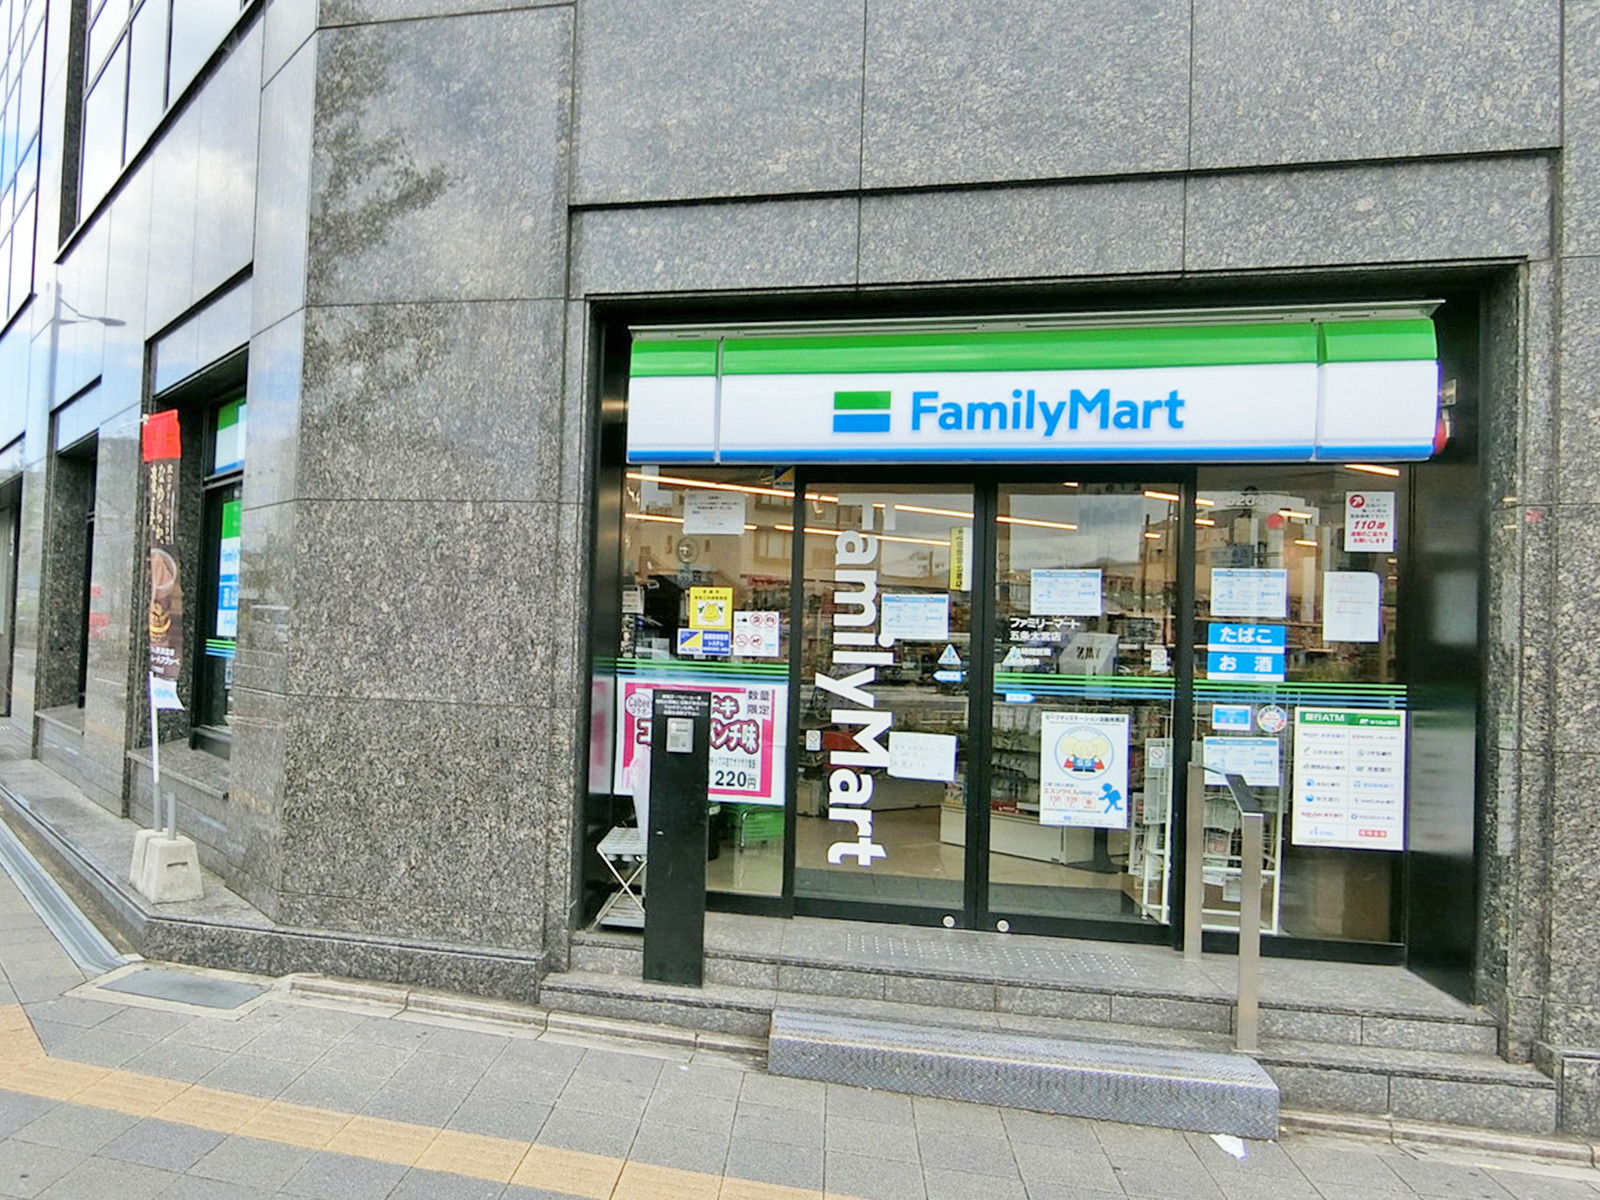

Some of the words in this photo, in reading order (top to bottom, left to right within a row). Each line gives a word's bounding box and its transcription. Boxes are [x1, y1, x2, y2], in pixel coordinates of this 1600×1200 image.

[911, 388, 1185, 437] FamilyMart
[1009, 617, 1081, 629] ファミリーマート
[1219, 626, 1272, 644] たばこ
[1219, 655, 1237, 671] お
[1253, 656, 1273, 672] 酒
[814, 493, 896, 867] FamilyMart
[747, 689, 770, 701] 数量
[747, 704, 770, 716] 限定
[709, 719, 760, 754] ンチ味
